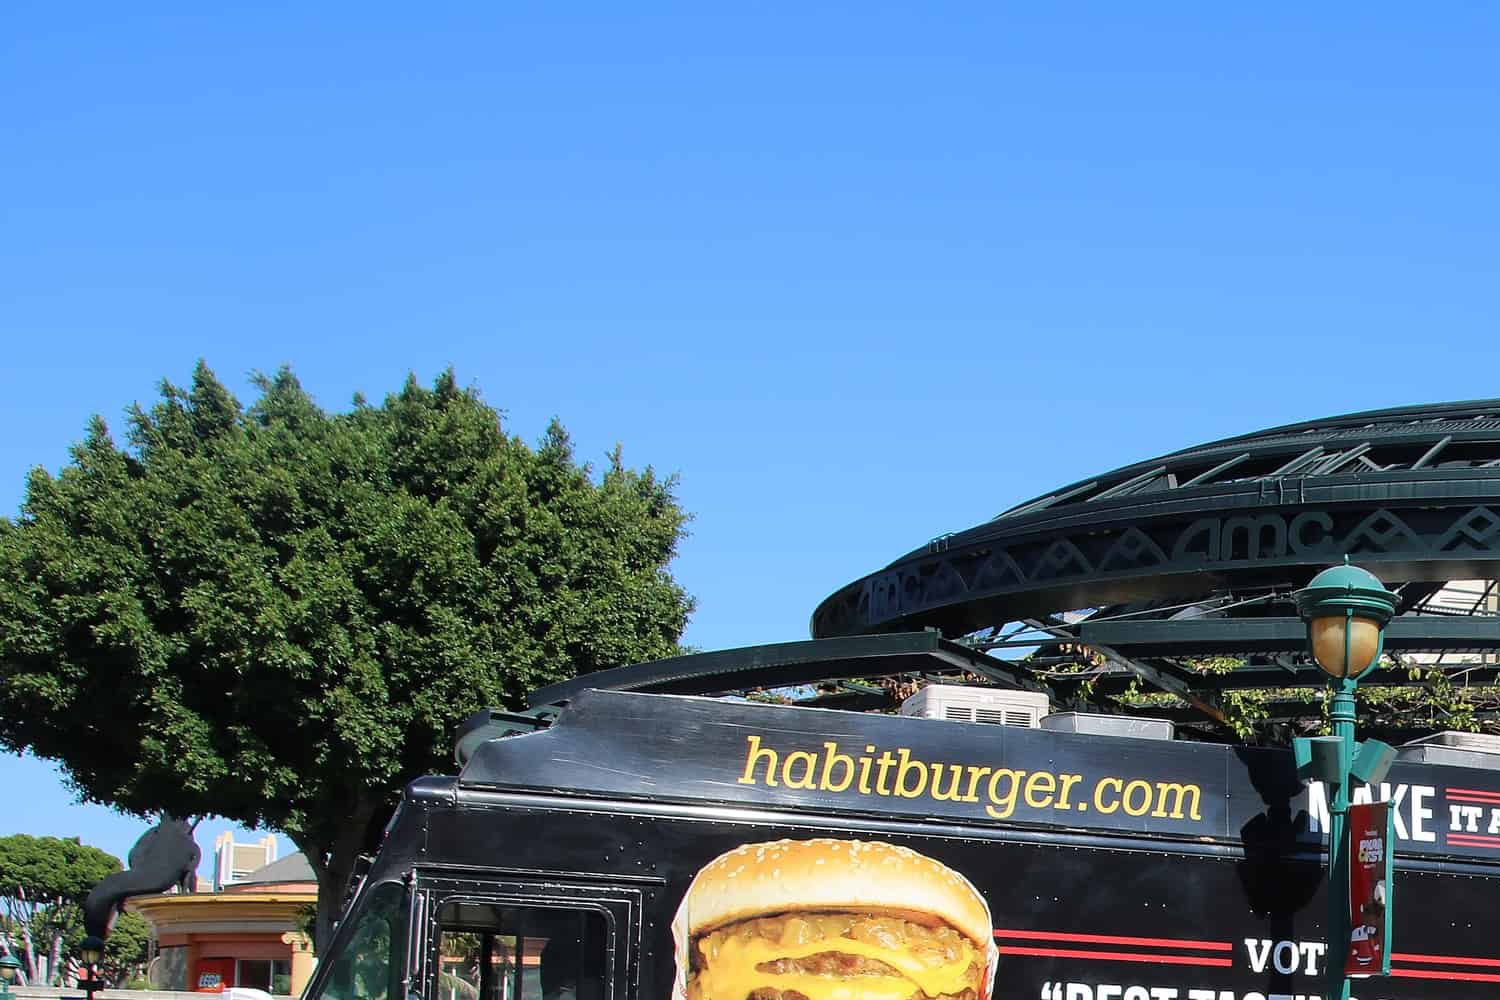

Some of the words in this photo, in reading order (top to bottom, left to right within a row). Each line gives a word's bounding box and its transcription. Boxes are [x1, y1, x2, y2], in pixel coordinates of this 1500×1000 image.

[737, 735, 1202, 821] habitburger.com
[1449, 804, 1482, 832] IT
[1244, 938, 1371, 977] VOT
